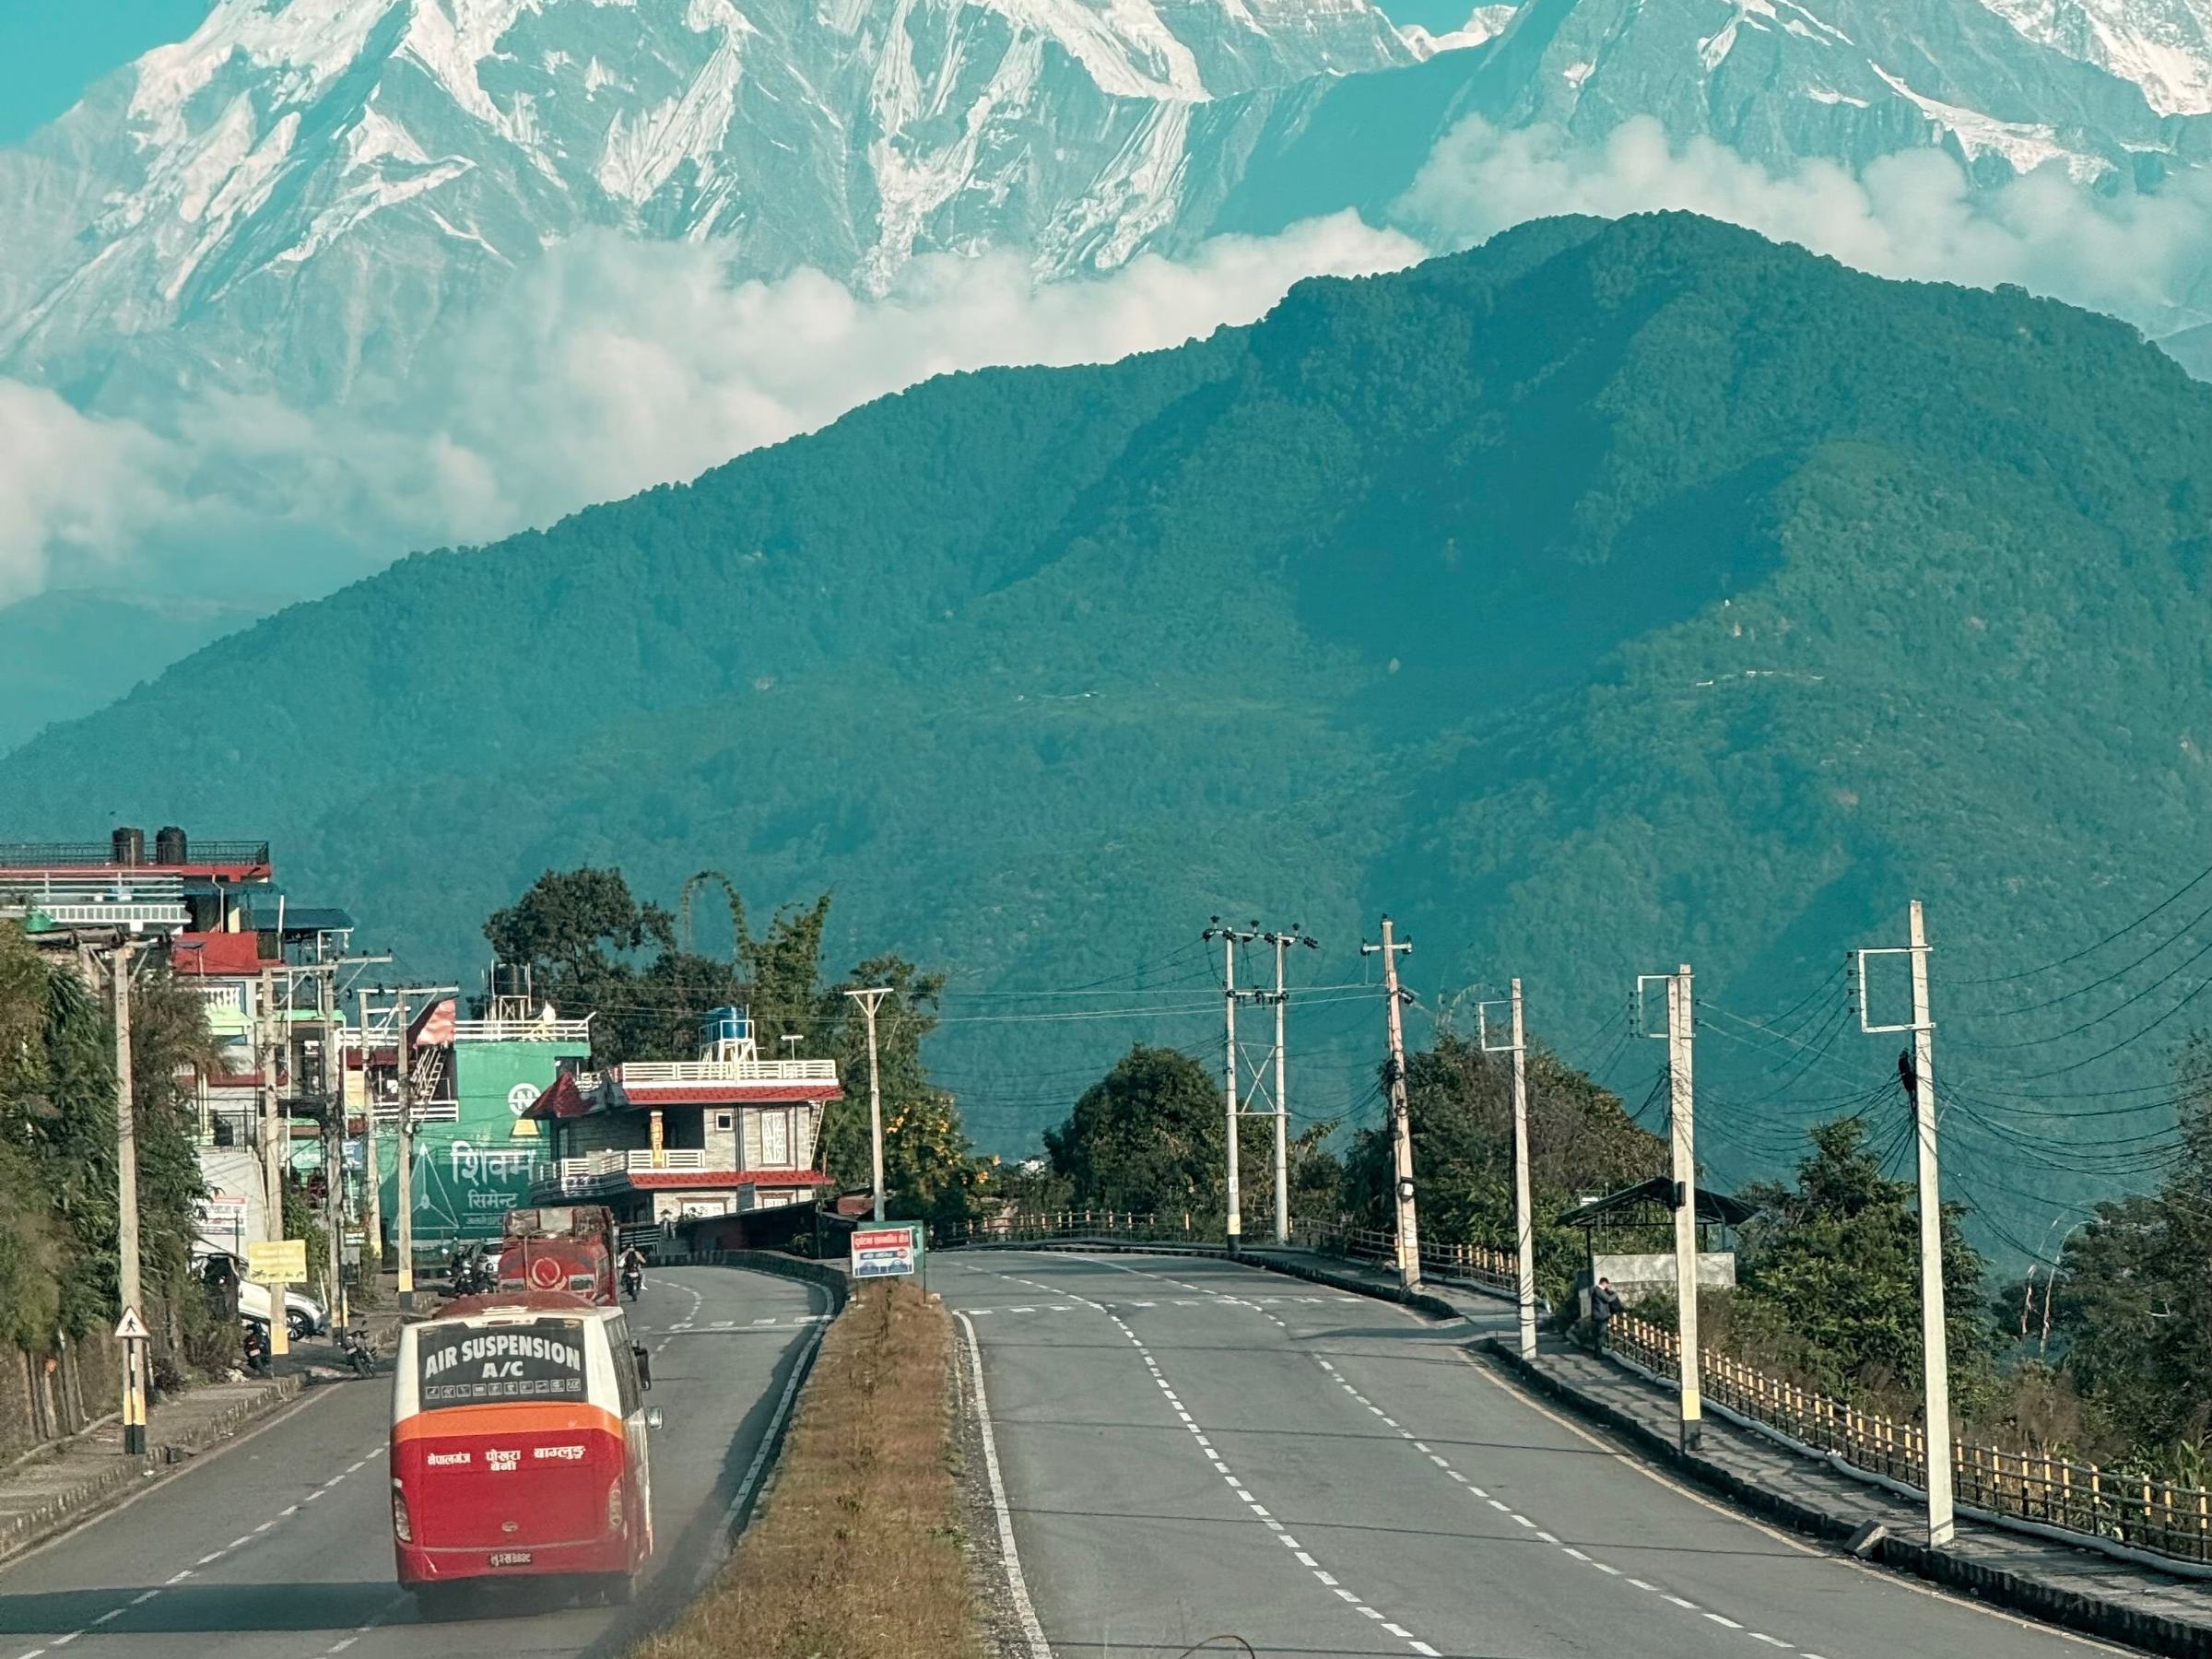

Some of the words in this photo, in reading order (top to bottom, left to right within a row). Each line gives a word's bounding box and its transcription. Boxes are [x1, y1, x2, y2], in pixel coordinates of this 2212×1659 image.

[467, 1189, 519, 1208] सिमेन्ट
[425, 1346, 458, 1379] AIR
[461, 1335, 582, 1371] SUSPENSION
[481, 1360, 524, 1379] A/C
[486, 1449, 522, 1462] पोखरा
